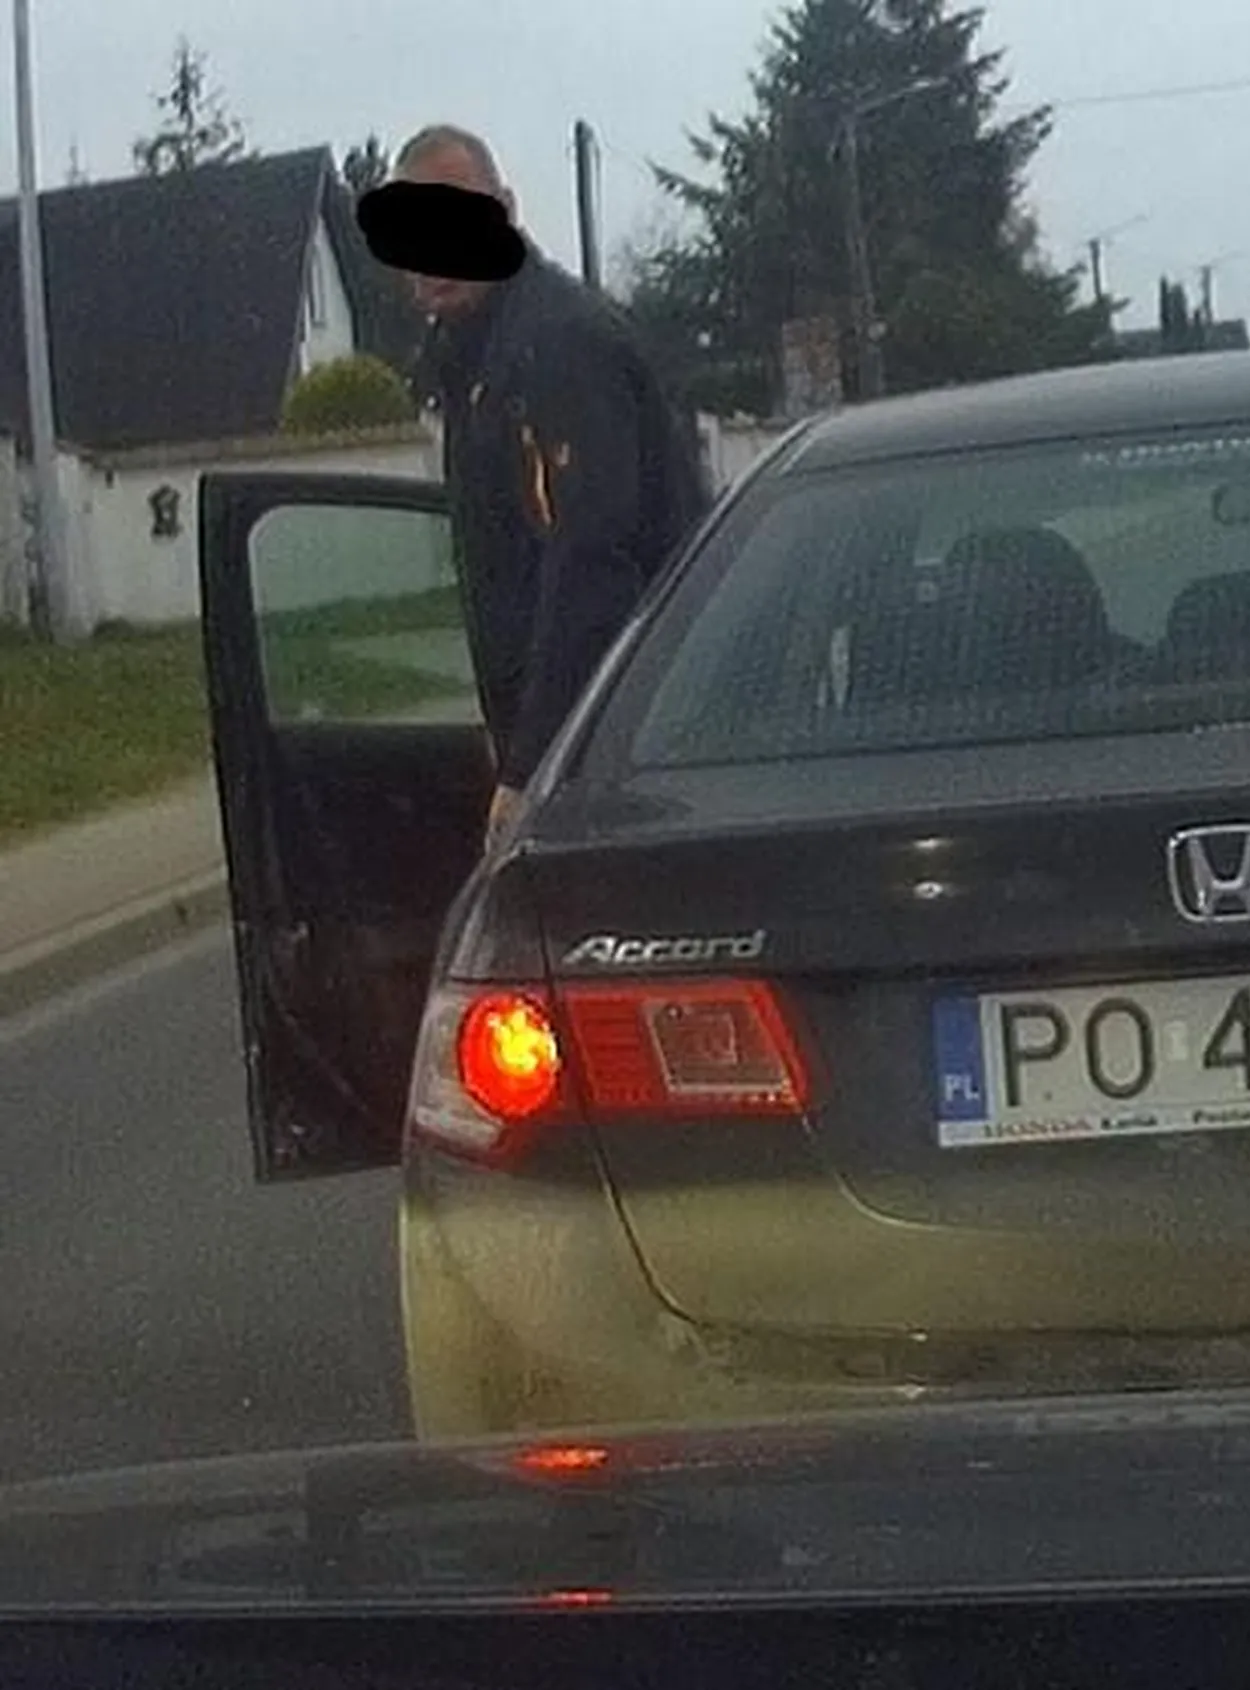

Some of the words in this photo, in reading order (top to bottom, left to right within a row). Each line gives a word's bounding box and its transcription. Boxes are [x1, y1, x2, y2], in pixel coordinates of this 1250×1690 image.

[561, 929, 767, 965] Accord
[1000, 997, 1155, 1107] PO
[945, 1074, 980, 1101] PL
